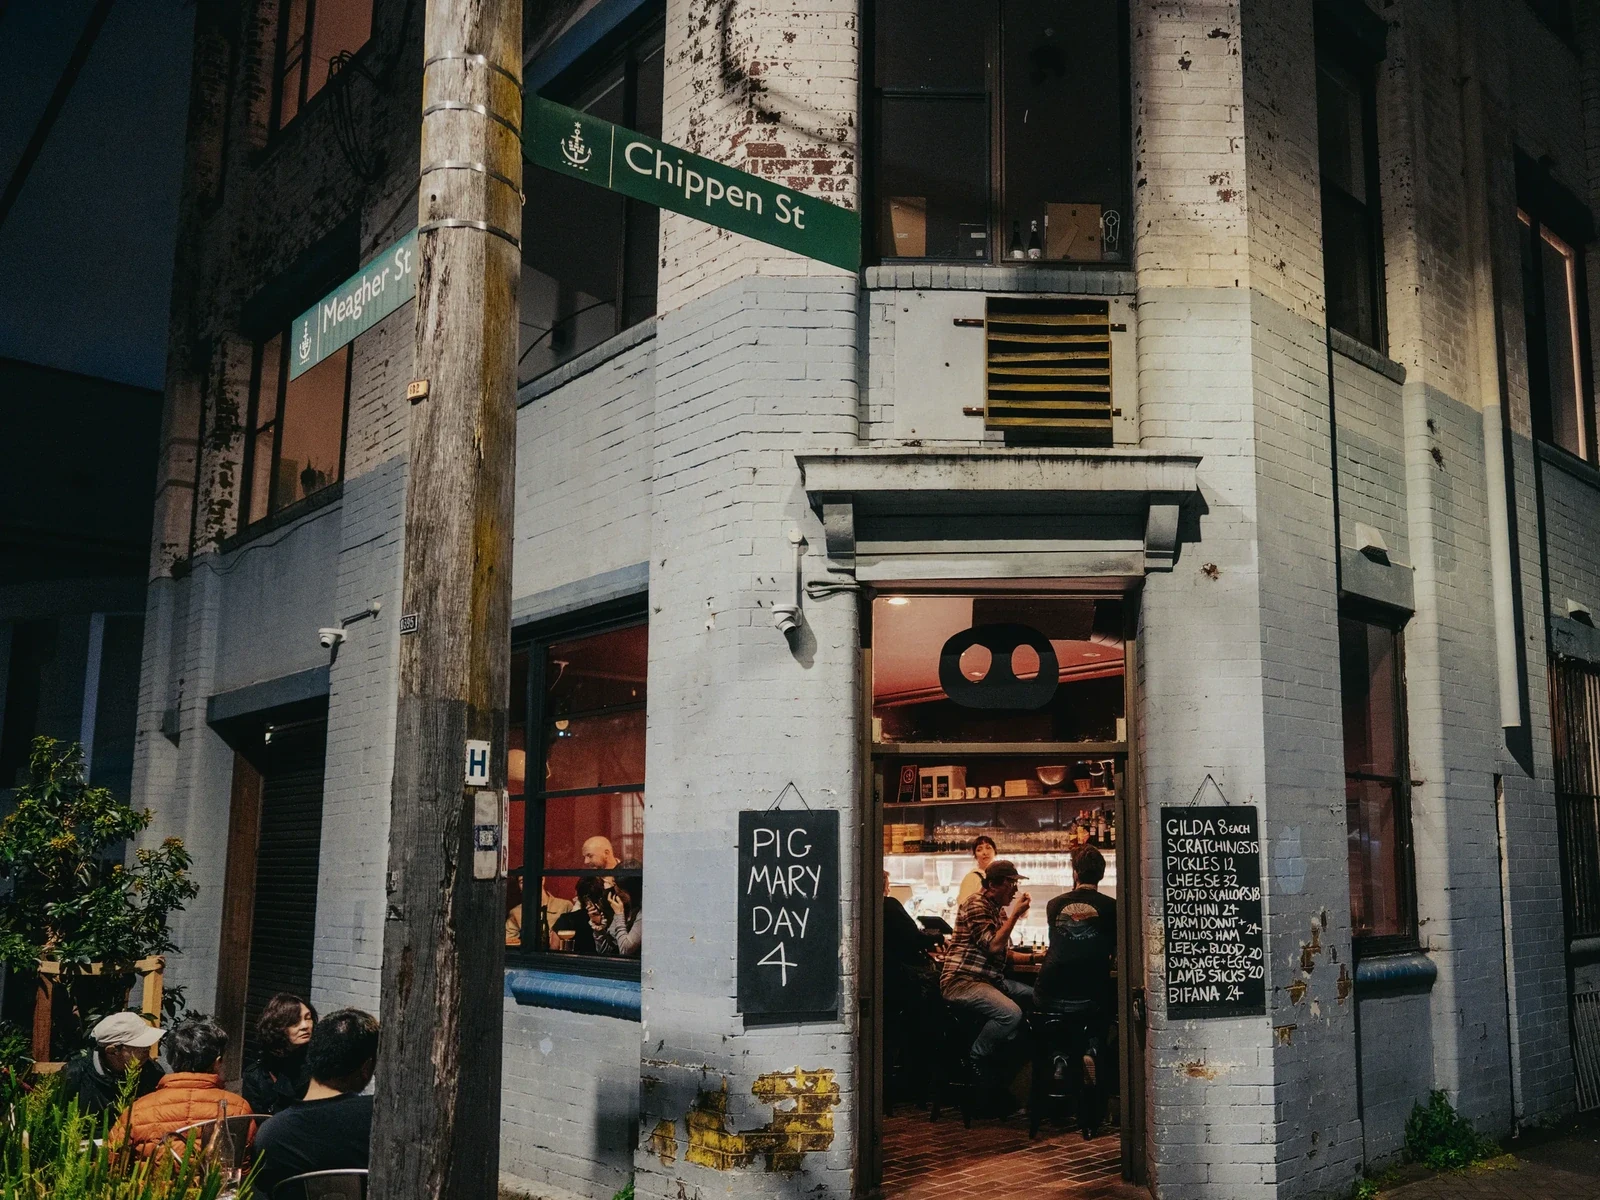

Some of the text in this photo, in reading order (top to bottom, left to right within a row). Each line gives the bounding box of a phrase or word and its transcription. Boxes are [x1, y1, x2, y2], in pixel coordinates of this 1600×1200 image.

[624, 141, 806, 230] Chippen St
[323, 247, 412, 333] Meagher St
[469, 749, 487, 777] H
[1166, 819, 1250, 836] GILDA 8 EACH
[753, 828, 812, 858] PIG
[1167, 838, 1250, 854] SCRATCHINGS
[1166, 856, 1237, 872] PICKLES 12
[747, 865, 822, 896] MARY
[1167, 873, 1239, 888] CHEESE 32
[1166, 887, 1207, 902] POTATO
[1209, 886, 1252, 902] SCALLOPS
[1167, 903, 1240, 916] ZUCCHINI 24
[753, 906, 810, 939] DAY
[1167, 916, 1198, 929] PARM
[1200, 916, 1239, 929] DONUT
[1171, 922, 1262, 942] EMILIOS HAM 24
[1209, 942, 1246, 956] BLOOD
[1247, 947, 1263, 960] 20
[757, 941, 798, 987] 4
[1168, 965, 1264, 985] LAMB STICKS 20
[1168, 984, 1244, 1003] BIFANA 24
